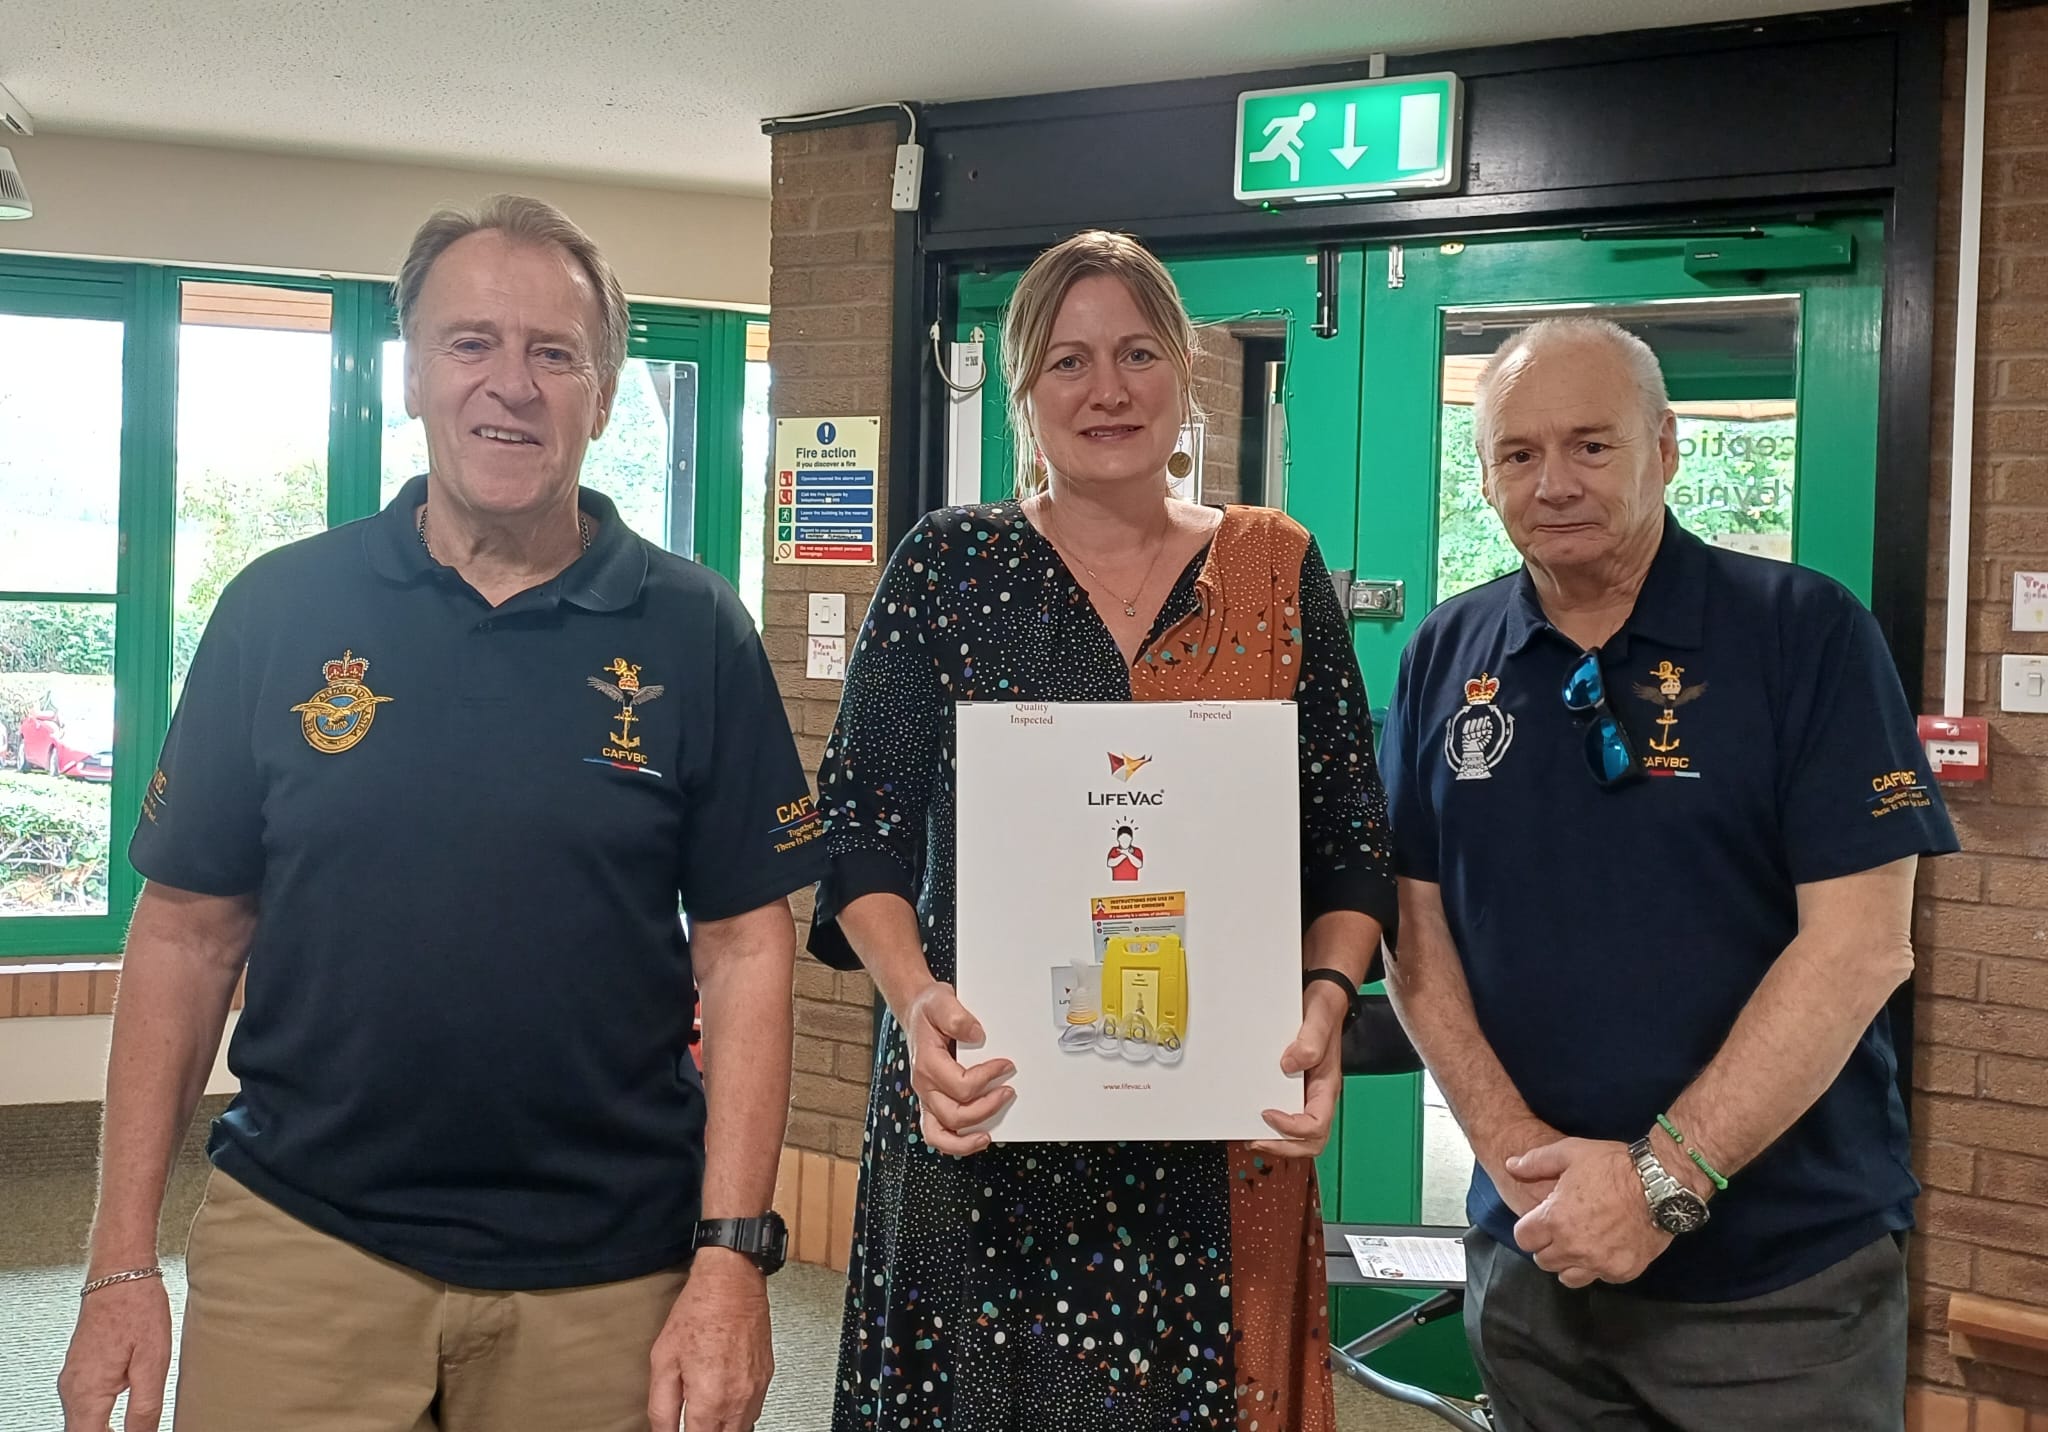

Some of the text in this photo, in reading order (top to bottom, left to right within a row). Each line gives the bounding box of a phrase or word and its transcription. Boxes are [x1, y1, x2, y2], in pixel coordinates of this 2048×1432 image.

[796, 447, 856, 458] Fire action
[1016, 704, 1048, 713] Quality
[1011, 715, 1053, 726] Inspected
[1189, 710, 1231, 721] Inspected
[602, 747, 648, 765] CAFVBC
[1642, 756, 1690, 768] AFVBC
